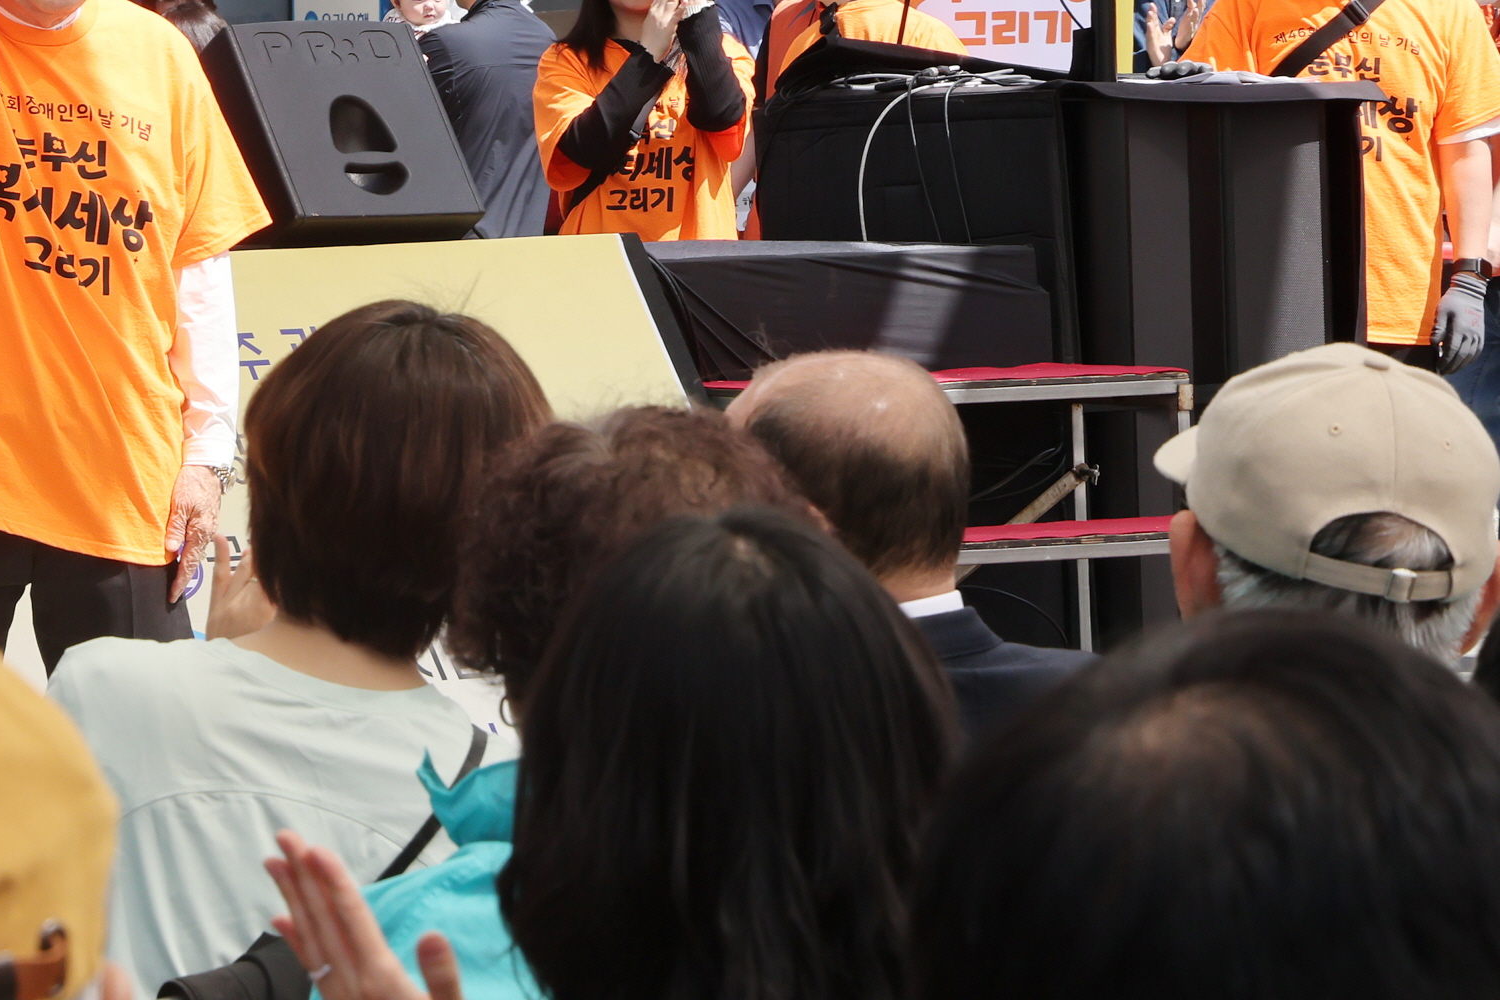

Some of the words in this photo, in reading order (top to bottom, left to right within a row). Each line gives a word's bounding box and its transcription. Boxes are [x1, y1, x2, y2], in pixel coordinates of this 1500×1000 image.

[955, 11, 1072, 46] 그리기
[1378, 33, 1392, 48] 날
[1395, 36, 1421, 56] 기념
[98, 108, 115, 129] 날
[121, 114, 152, 142] 기념
[605, 186, 674, 212] 그리기
